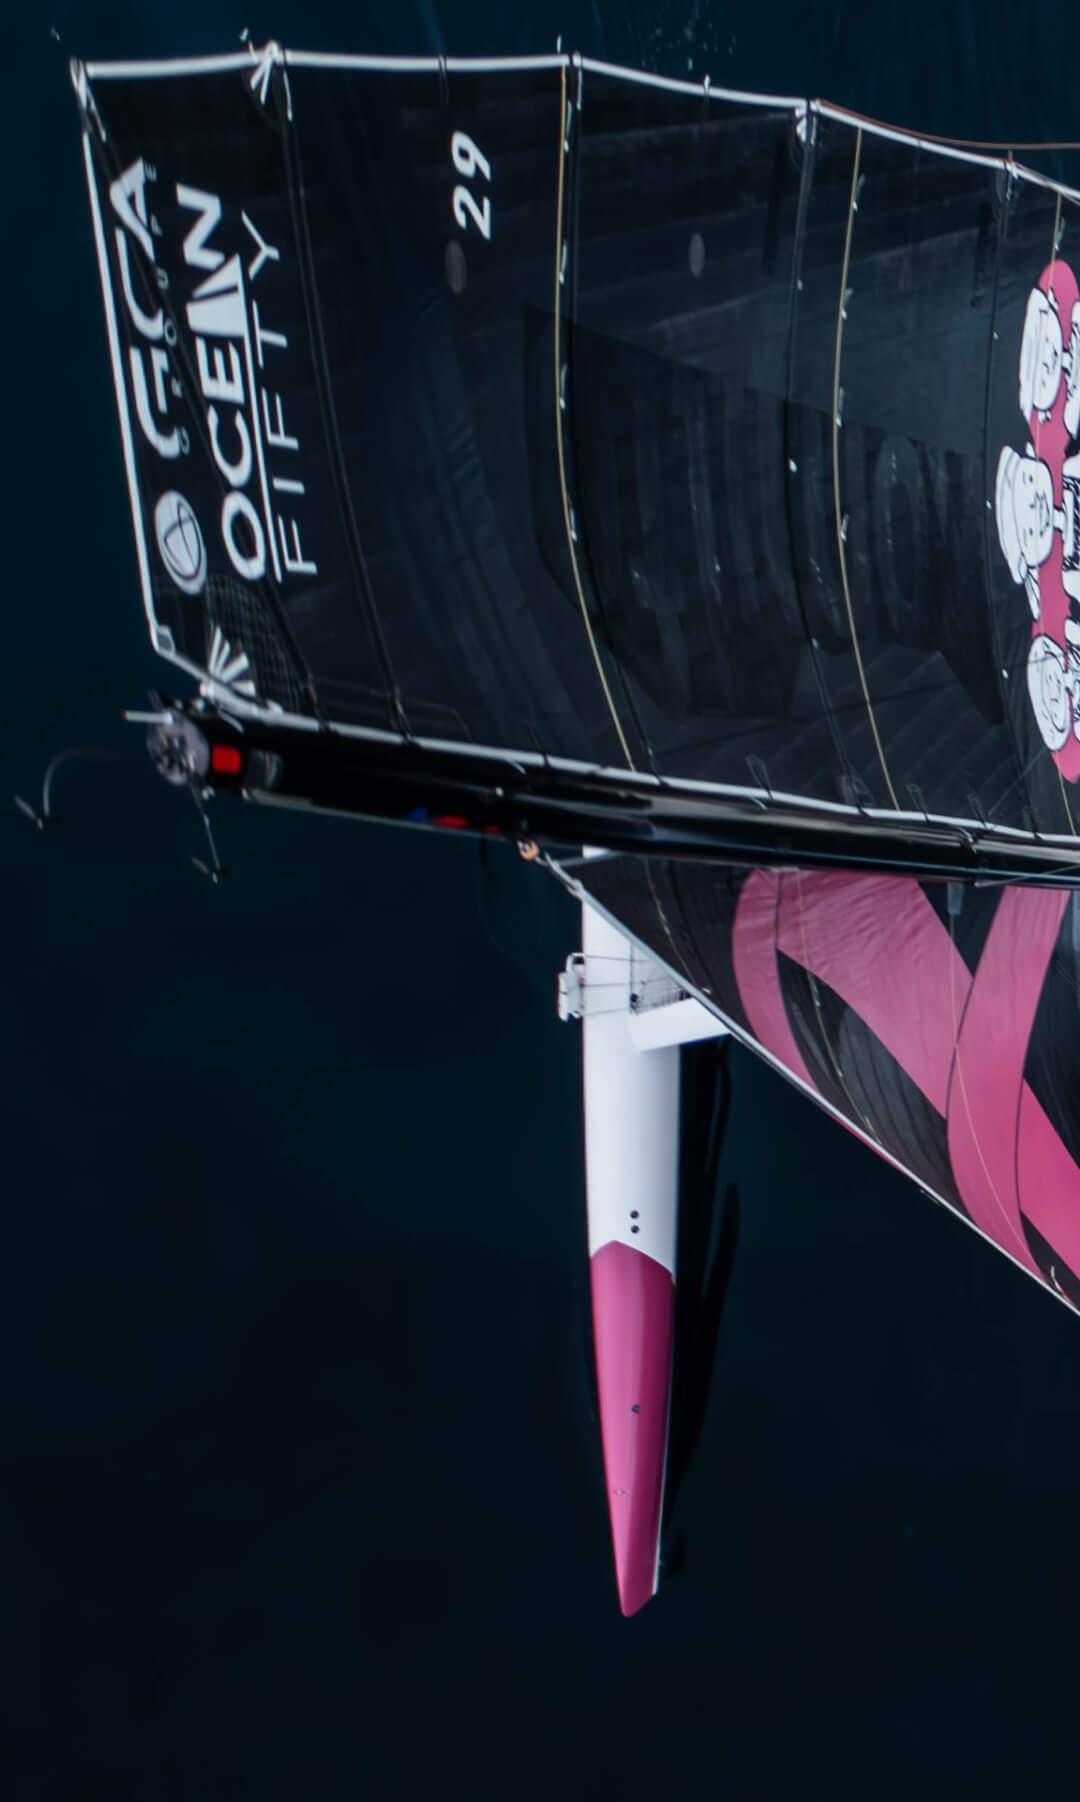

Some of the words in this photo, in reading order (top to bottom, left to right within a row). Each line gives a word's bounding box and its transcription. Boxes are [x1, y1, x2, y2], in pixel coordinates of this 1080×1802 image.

[110, 157, 181, 459] GCA
[451, 129, 491, 241] 29
[176, 183, 267, 580] OCEAN
[241, 210, 317, 575] FIFTY
